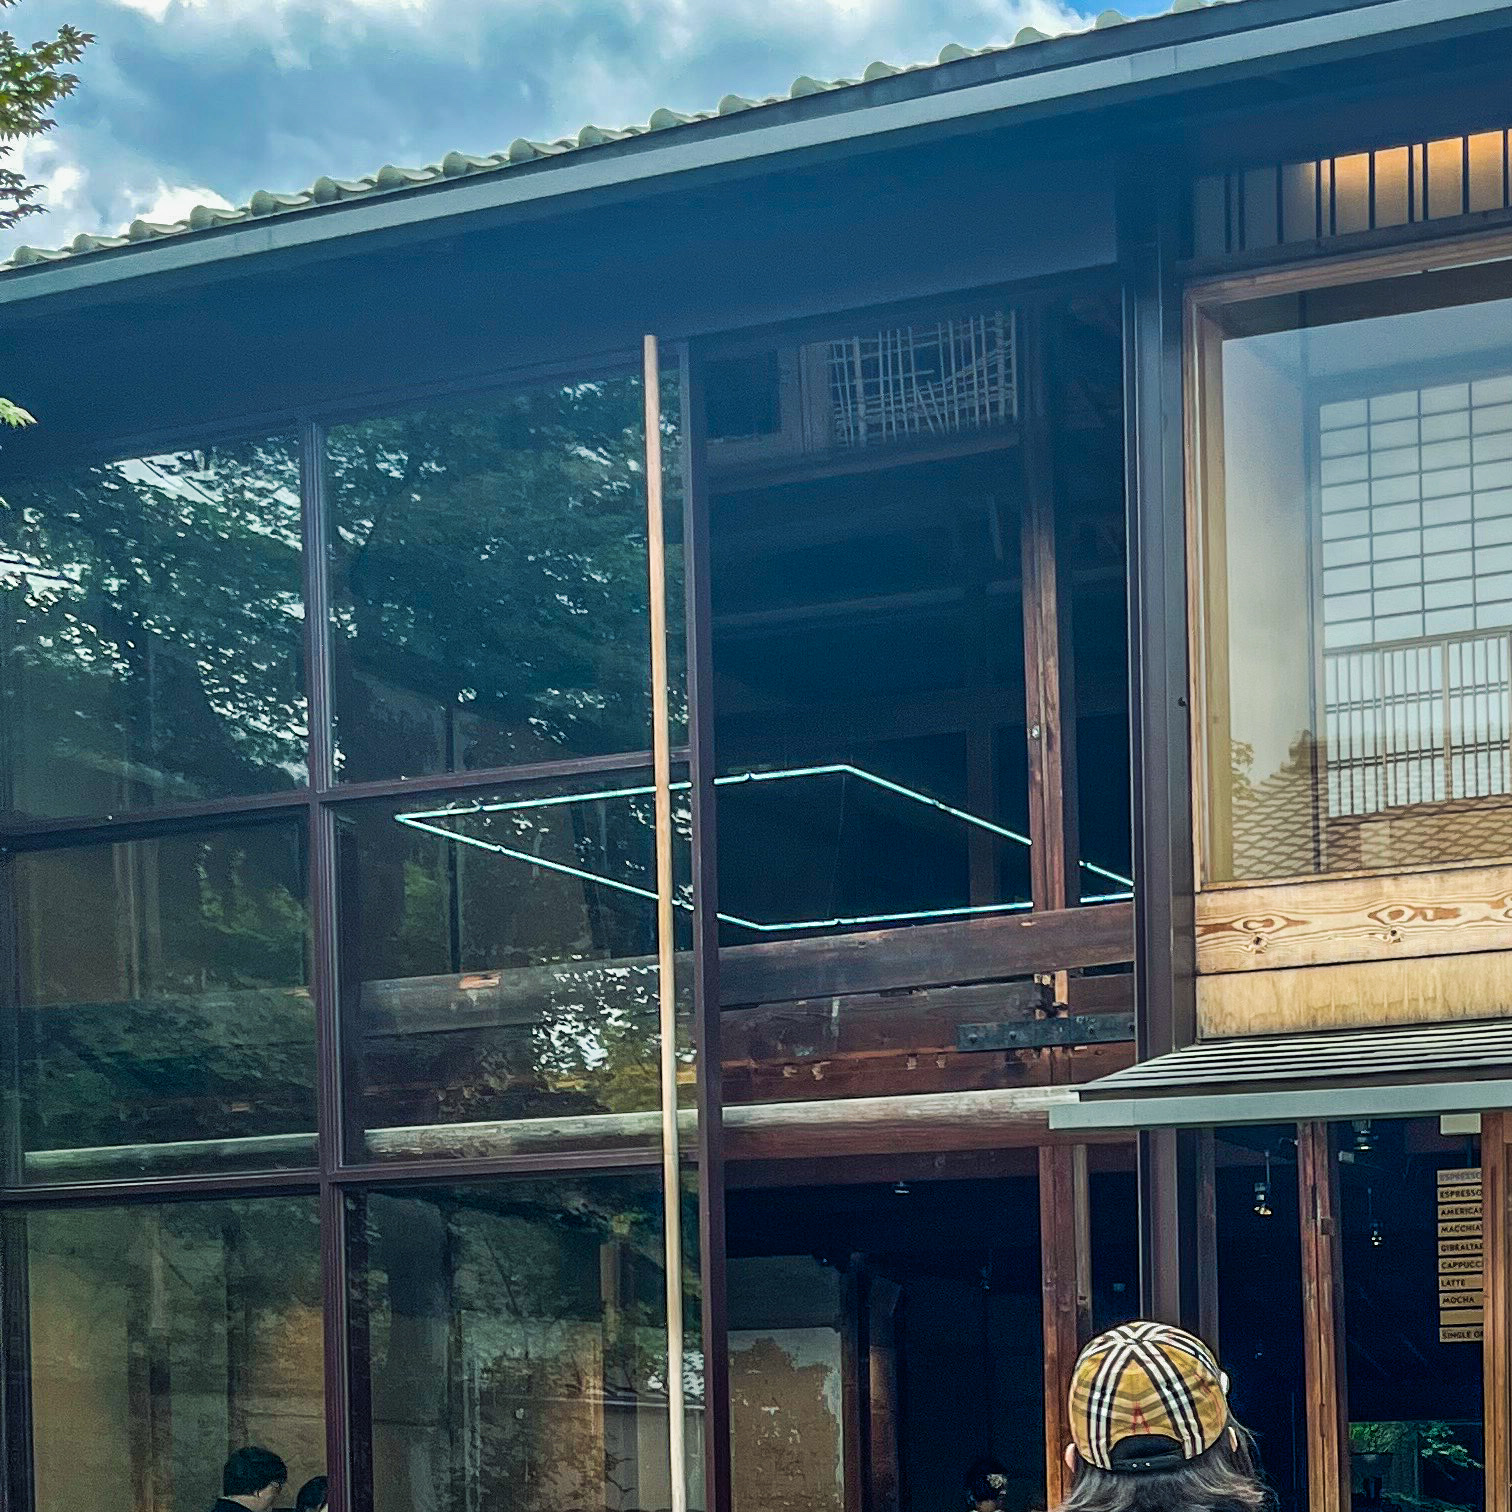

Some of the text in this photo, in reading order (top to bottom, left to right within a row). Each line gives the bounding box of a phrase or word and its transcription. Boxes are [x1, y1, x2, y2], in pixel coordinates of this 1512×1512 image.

[1441, 1260, 1483, 1269] CAPPUCC
[1440, 1279, 1466, 1288] LATTE
[1442, 1296, 1475, 1305] MOCHA
[1441, 1330, 1471, 1340] SINGLE
